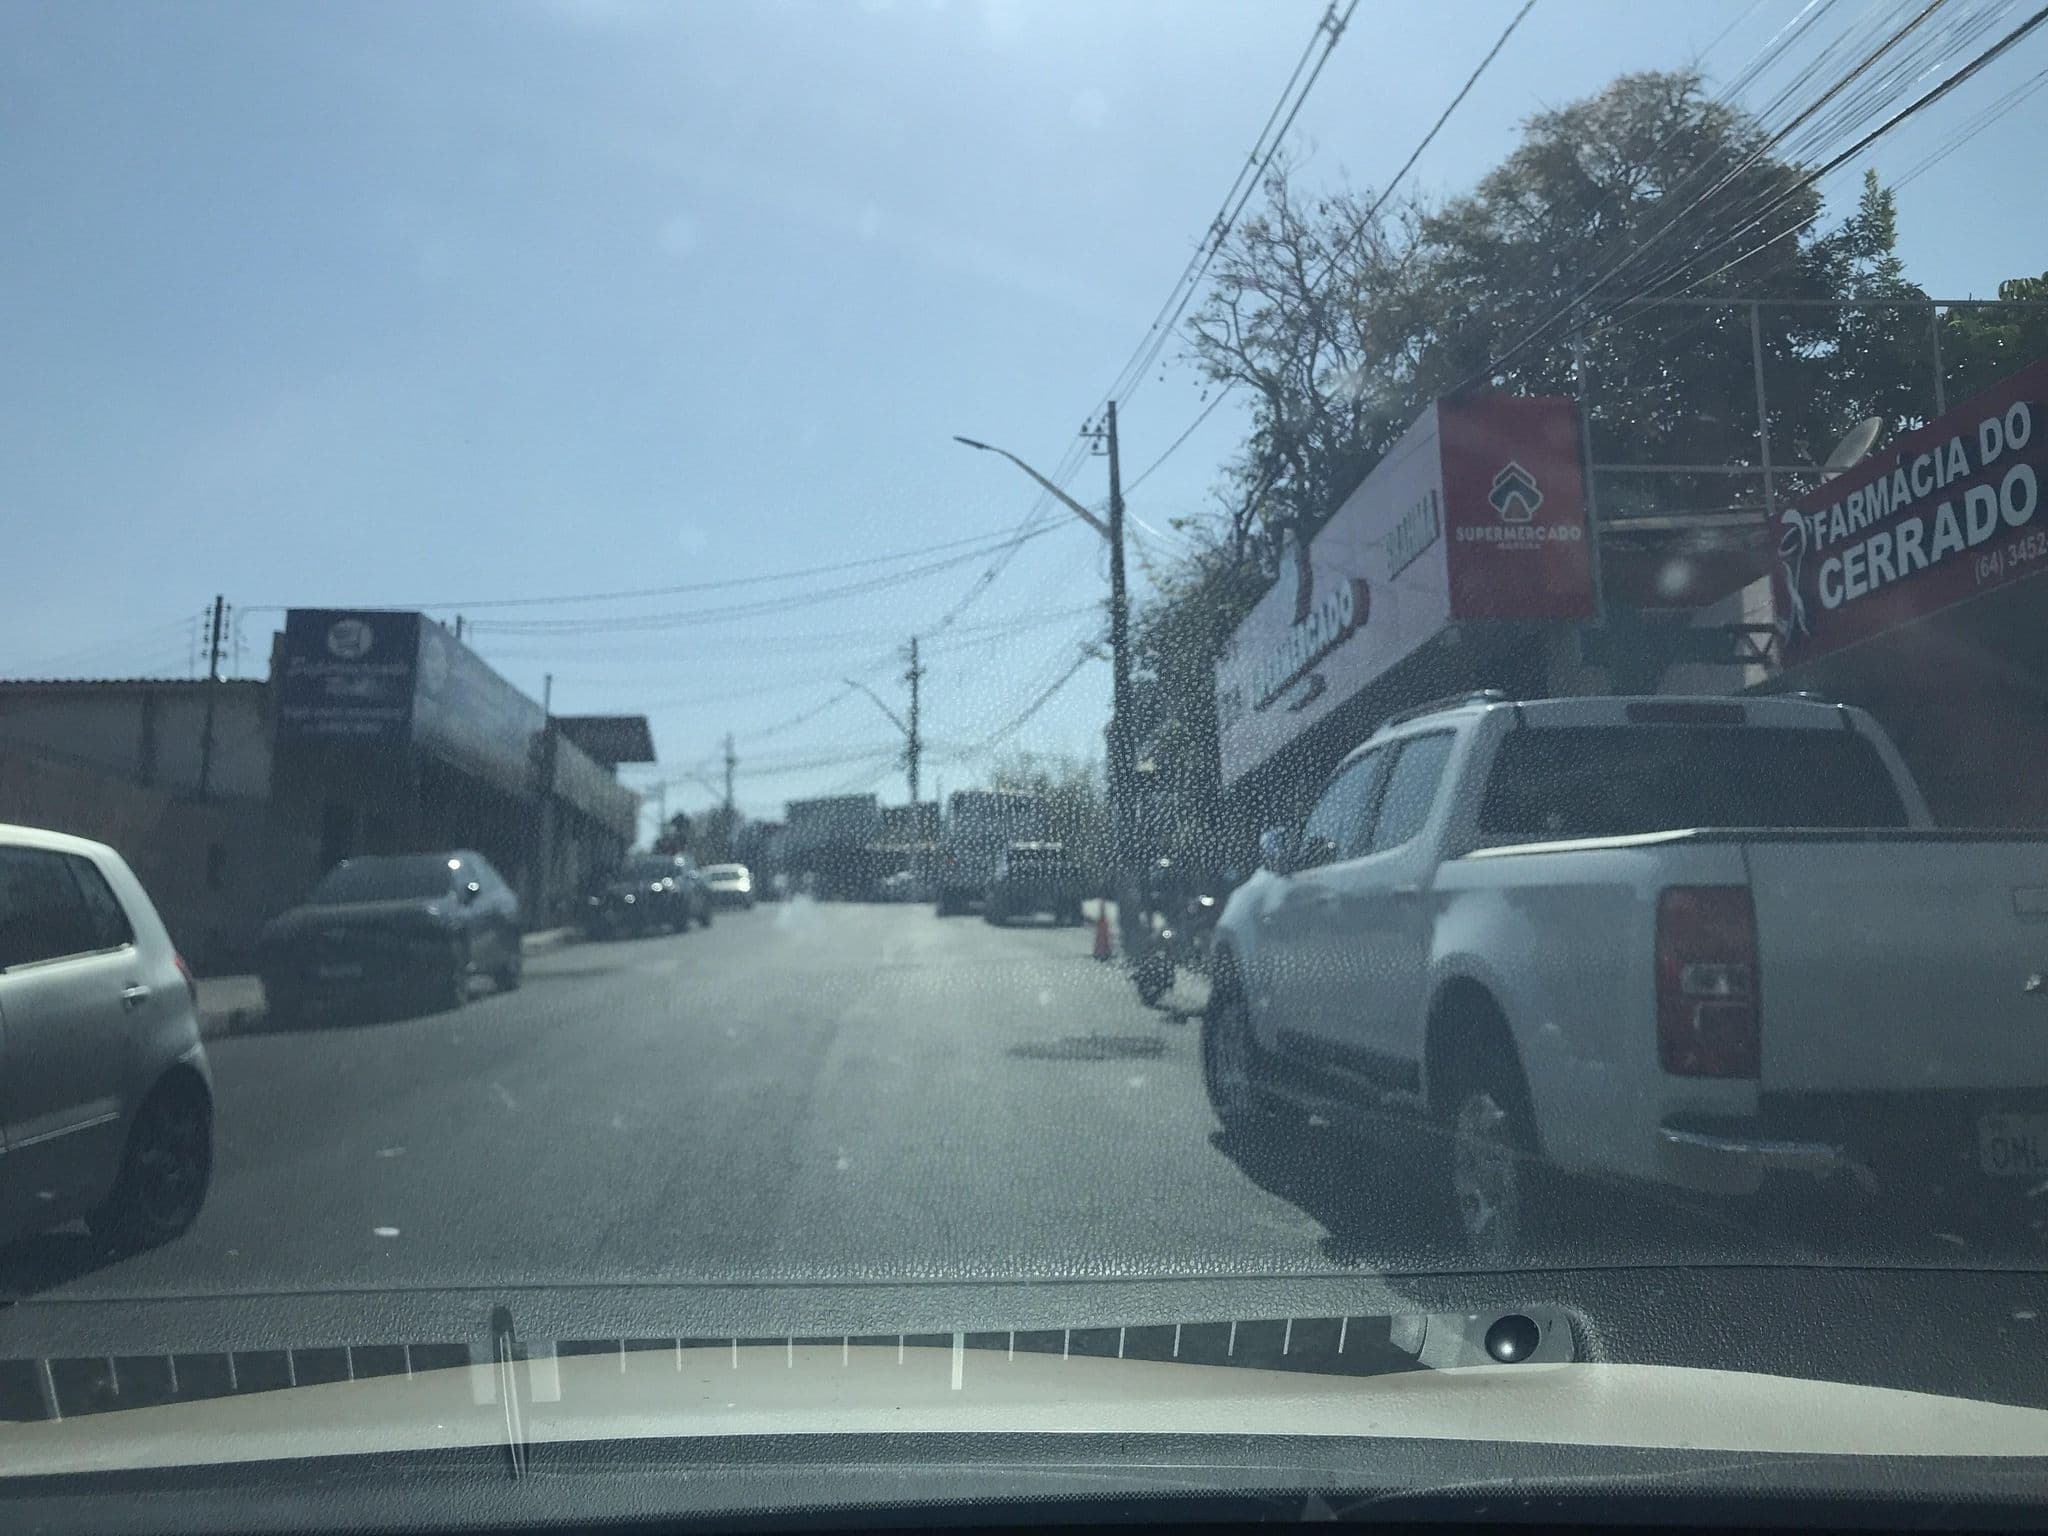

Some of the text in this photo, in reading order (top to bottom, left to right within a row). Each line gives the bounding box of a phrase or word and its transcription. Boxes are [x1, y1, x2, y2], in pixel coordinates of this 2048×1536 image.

[1811, 401, 2031, 551] FARMÁCIA DO
[1456, 526, 1581, 542] SUPERMERCADO
[1819, 463, 2038, 609] CERRADO
[1975, 549, 2004, 585] (64)
